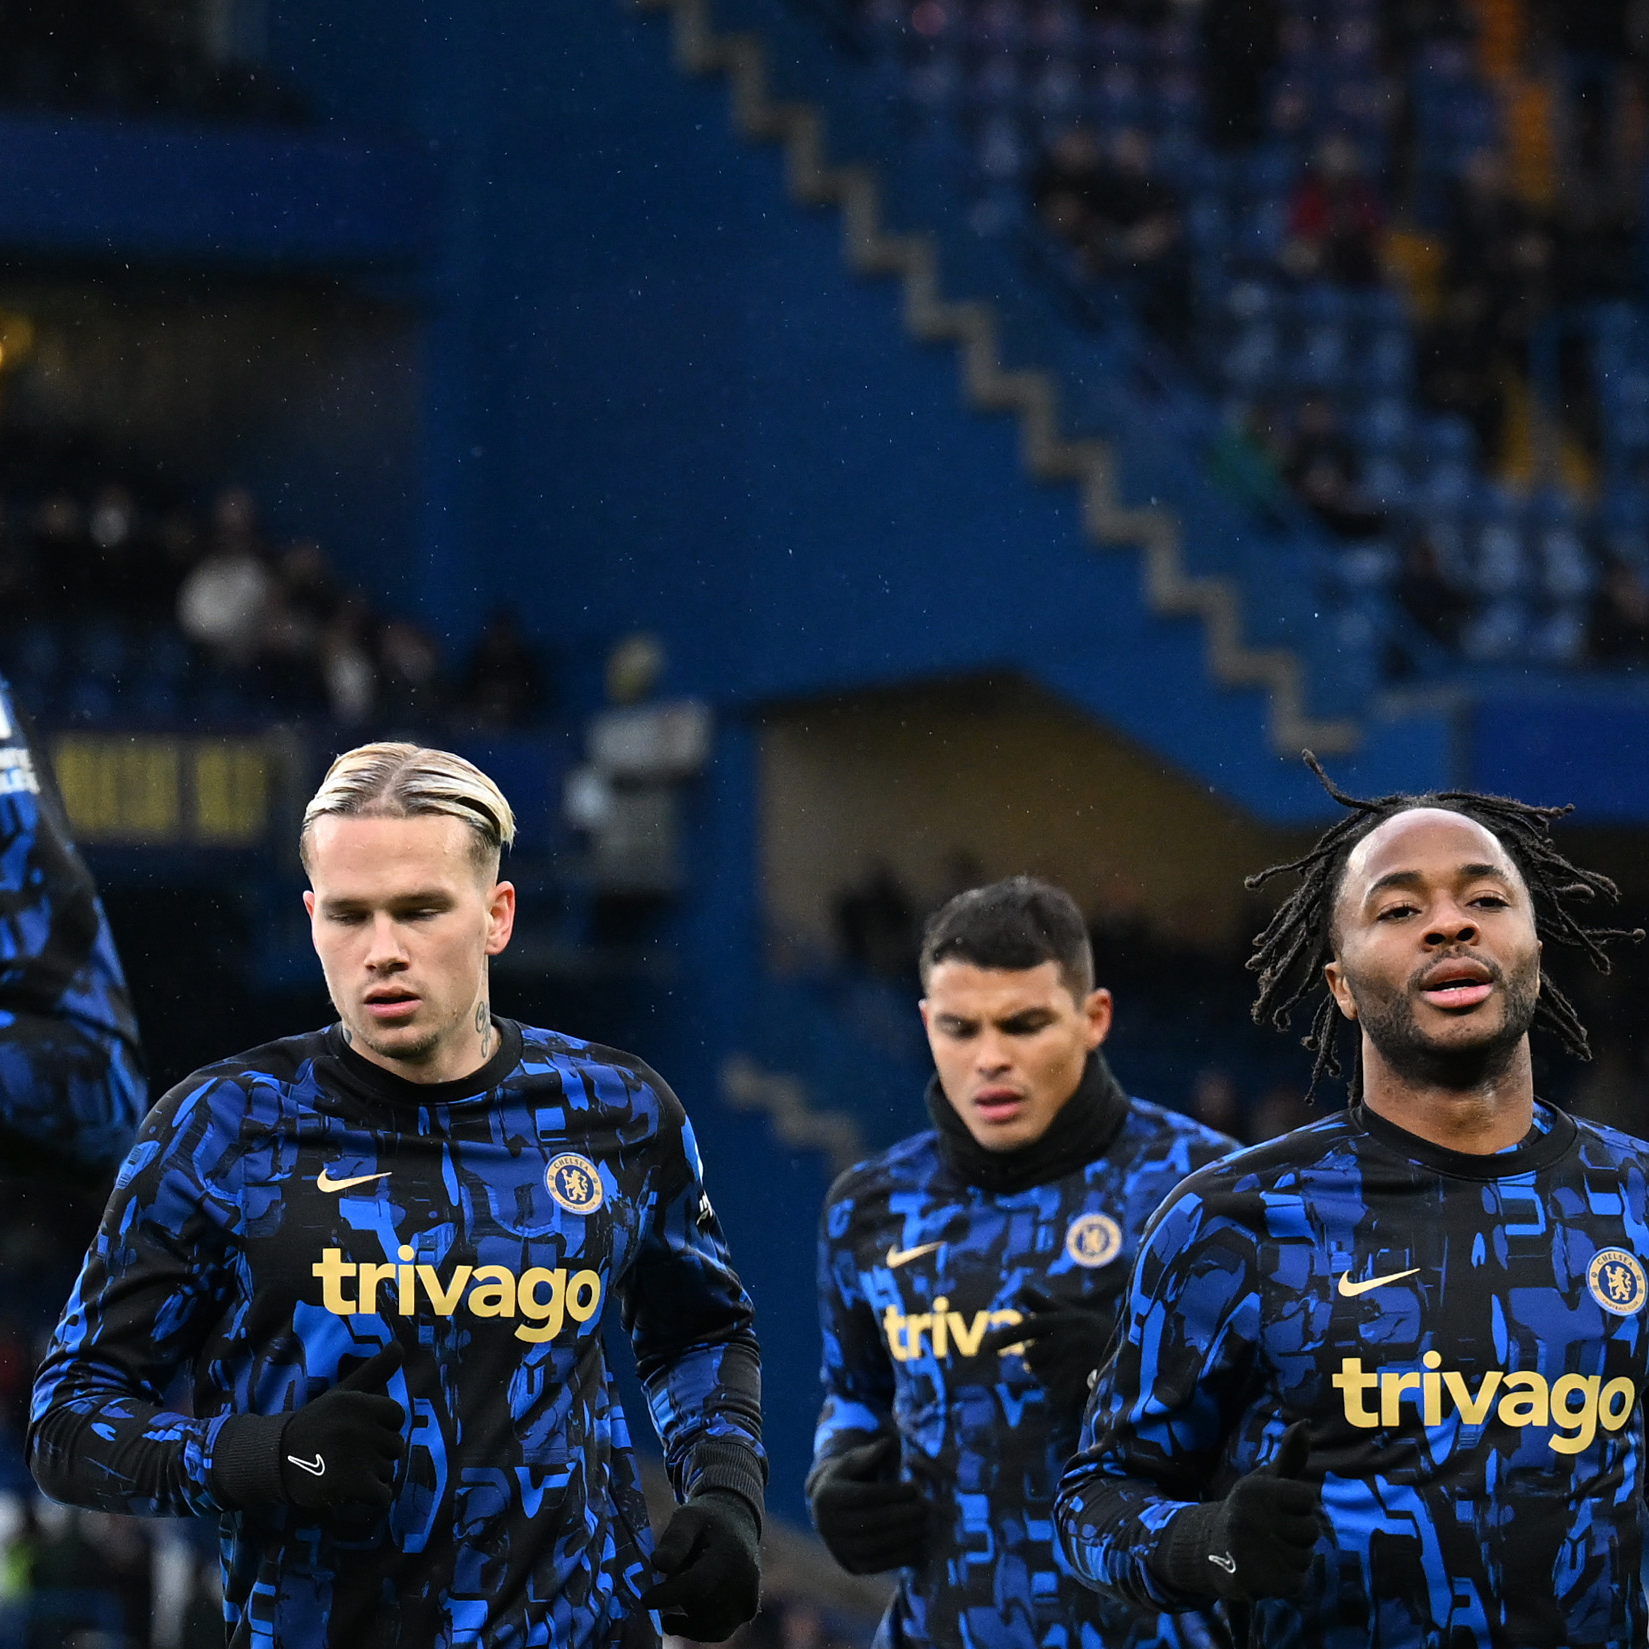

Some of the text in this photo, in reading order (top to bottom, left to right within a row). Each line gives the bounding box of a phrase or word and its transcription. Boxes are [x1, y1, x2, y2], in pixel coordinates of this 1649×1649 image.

[553, 1157, 589, 1171] CHELSEA
[1596, 1252, 1633, 1267] CHELSEA
[312, 1244, 601, 1343] trivago
[883, 1296, 1026, 1361] triv
[1331, 1350, 1635, 1455] trivago
